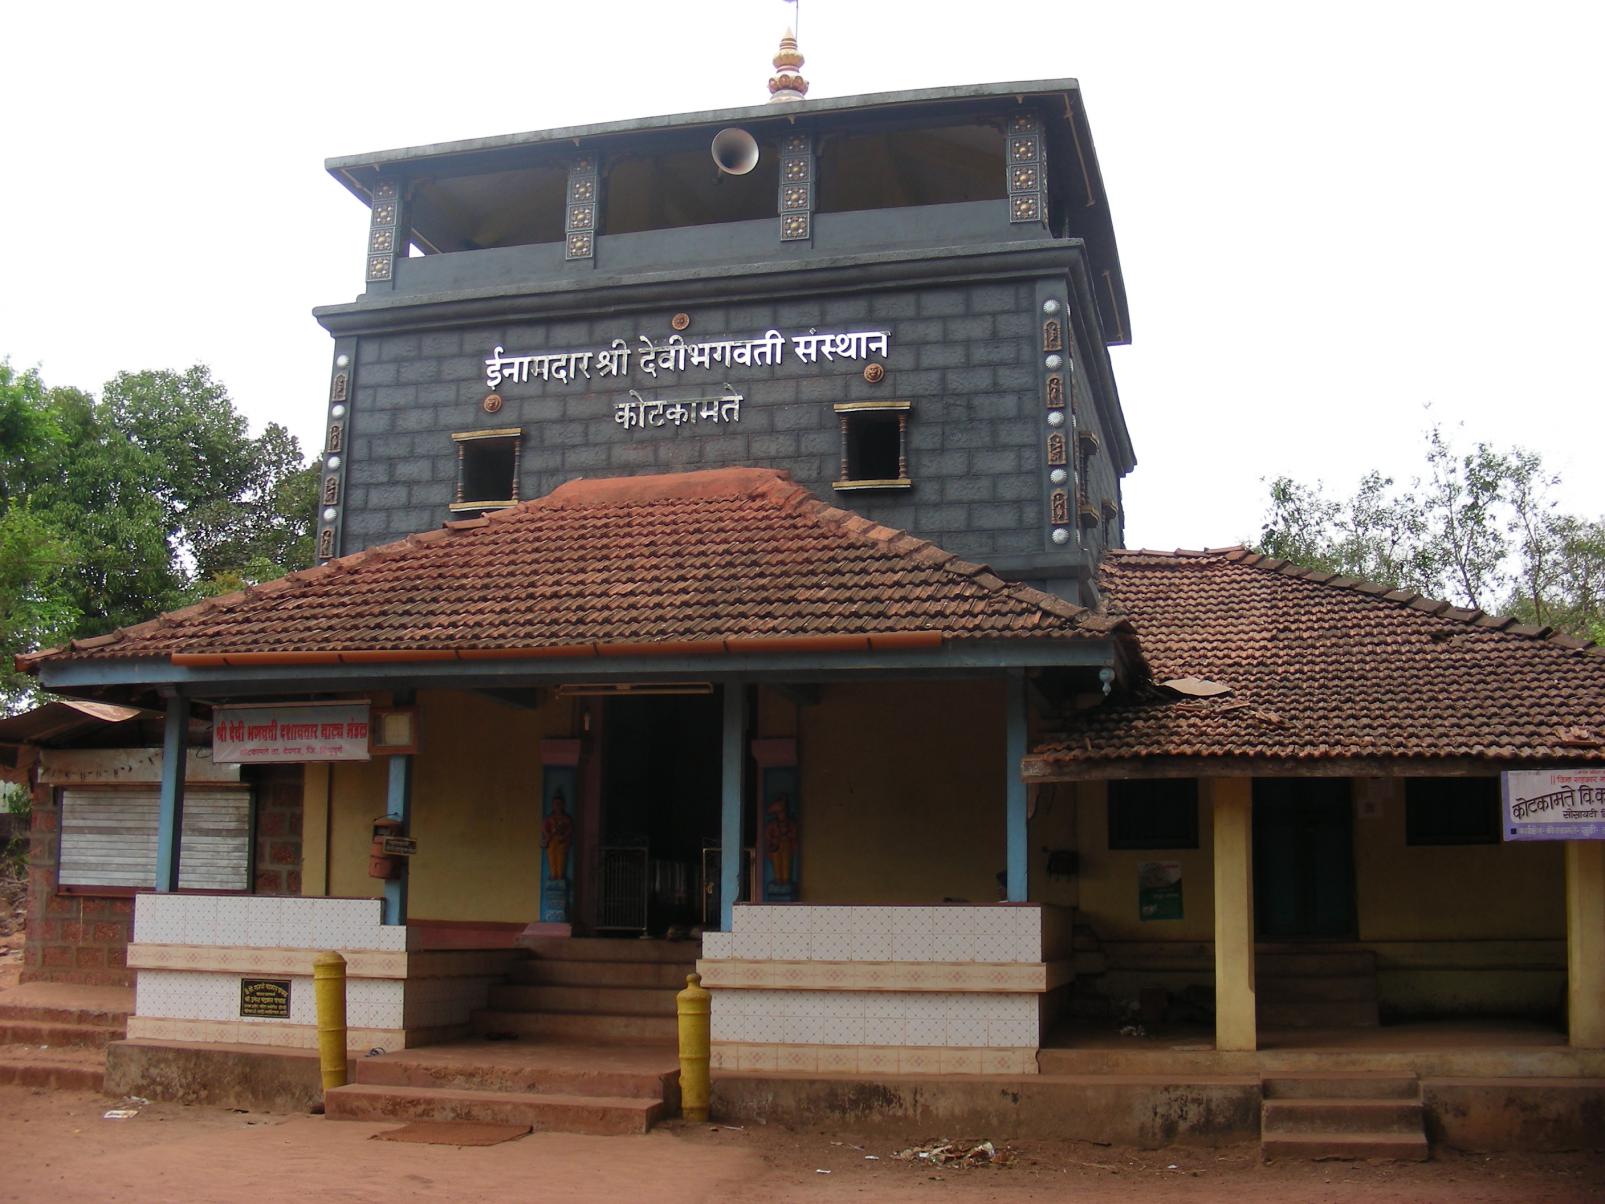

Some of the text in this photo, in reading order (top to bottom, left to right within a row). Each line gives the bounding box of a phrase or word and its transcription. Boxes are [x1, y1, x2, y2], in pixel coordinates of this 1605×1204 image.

[484, 346, 593, 391] ईनामदार
[595, 338, 631, 377] श्री
[791, 327, 892, 364] संस्थान
[613, 382, 743, 430] कोटकामते
[1512, 785, 1576, 819] कोटकामते
